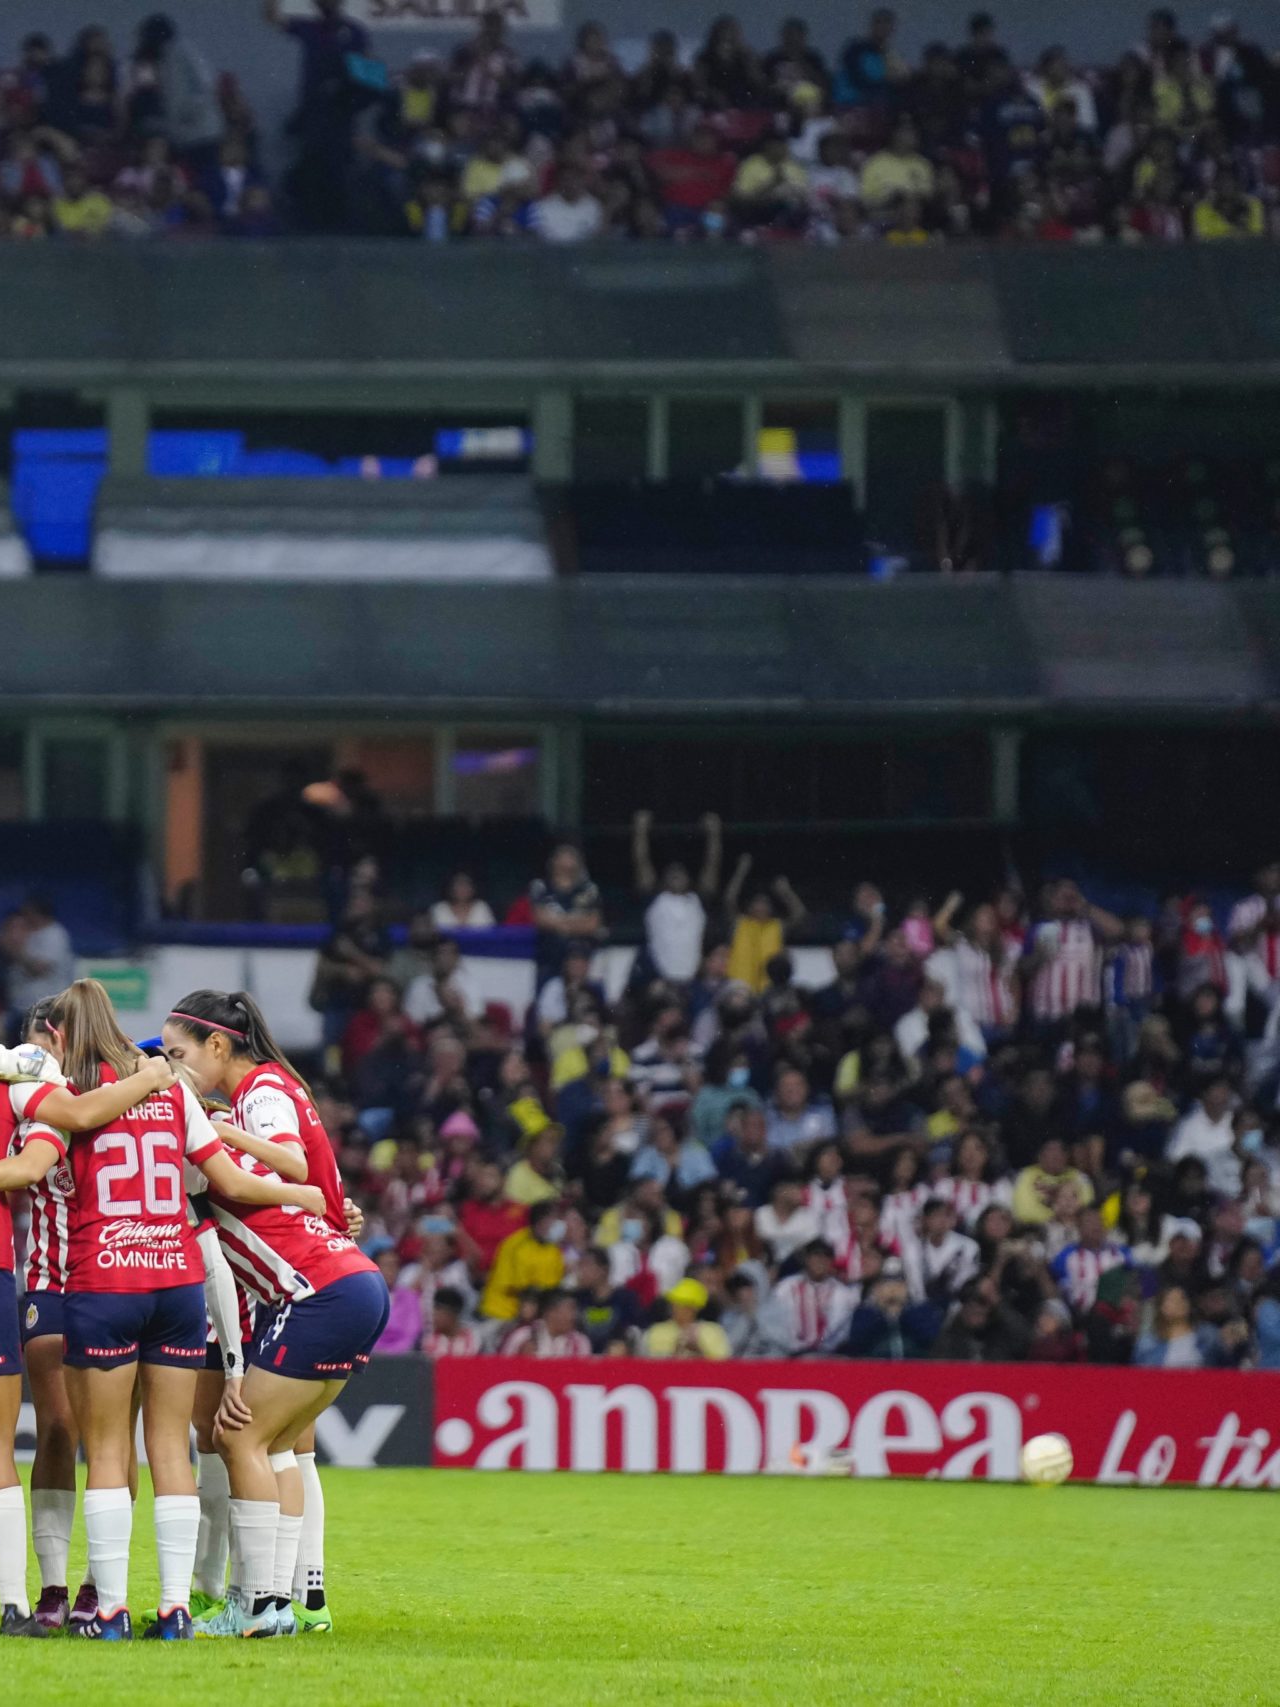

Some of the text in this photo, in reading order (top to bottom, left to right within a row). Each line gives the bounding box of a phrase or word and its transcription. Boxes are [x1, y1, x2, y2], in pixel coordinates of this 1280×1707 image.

[120, 1102, 174, 1120] ORRES
[94, 1131, 181, 1216] 26
[99, 1218, 182, 1244] Caliente
[97, 1250, 187, 1270] OMNILIFE
[1095, 1409, 1177, 1487] Lo
